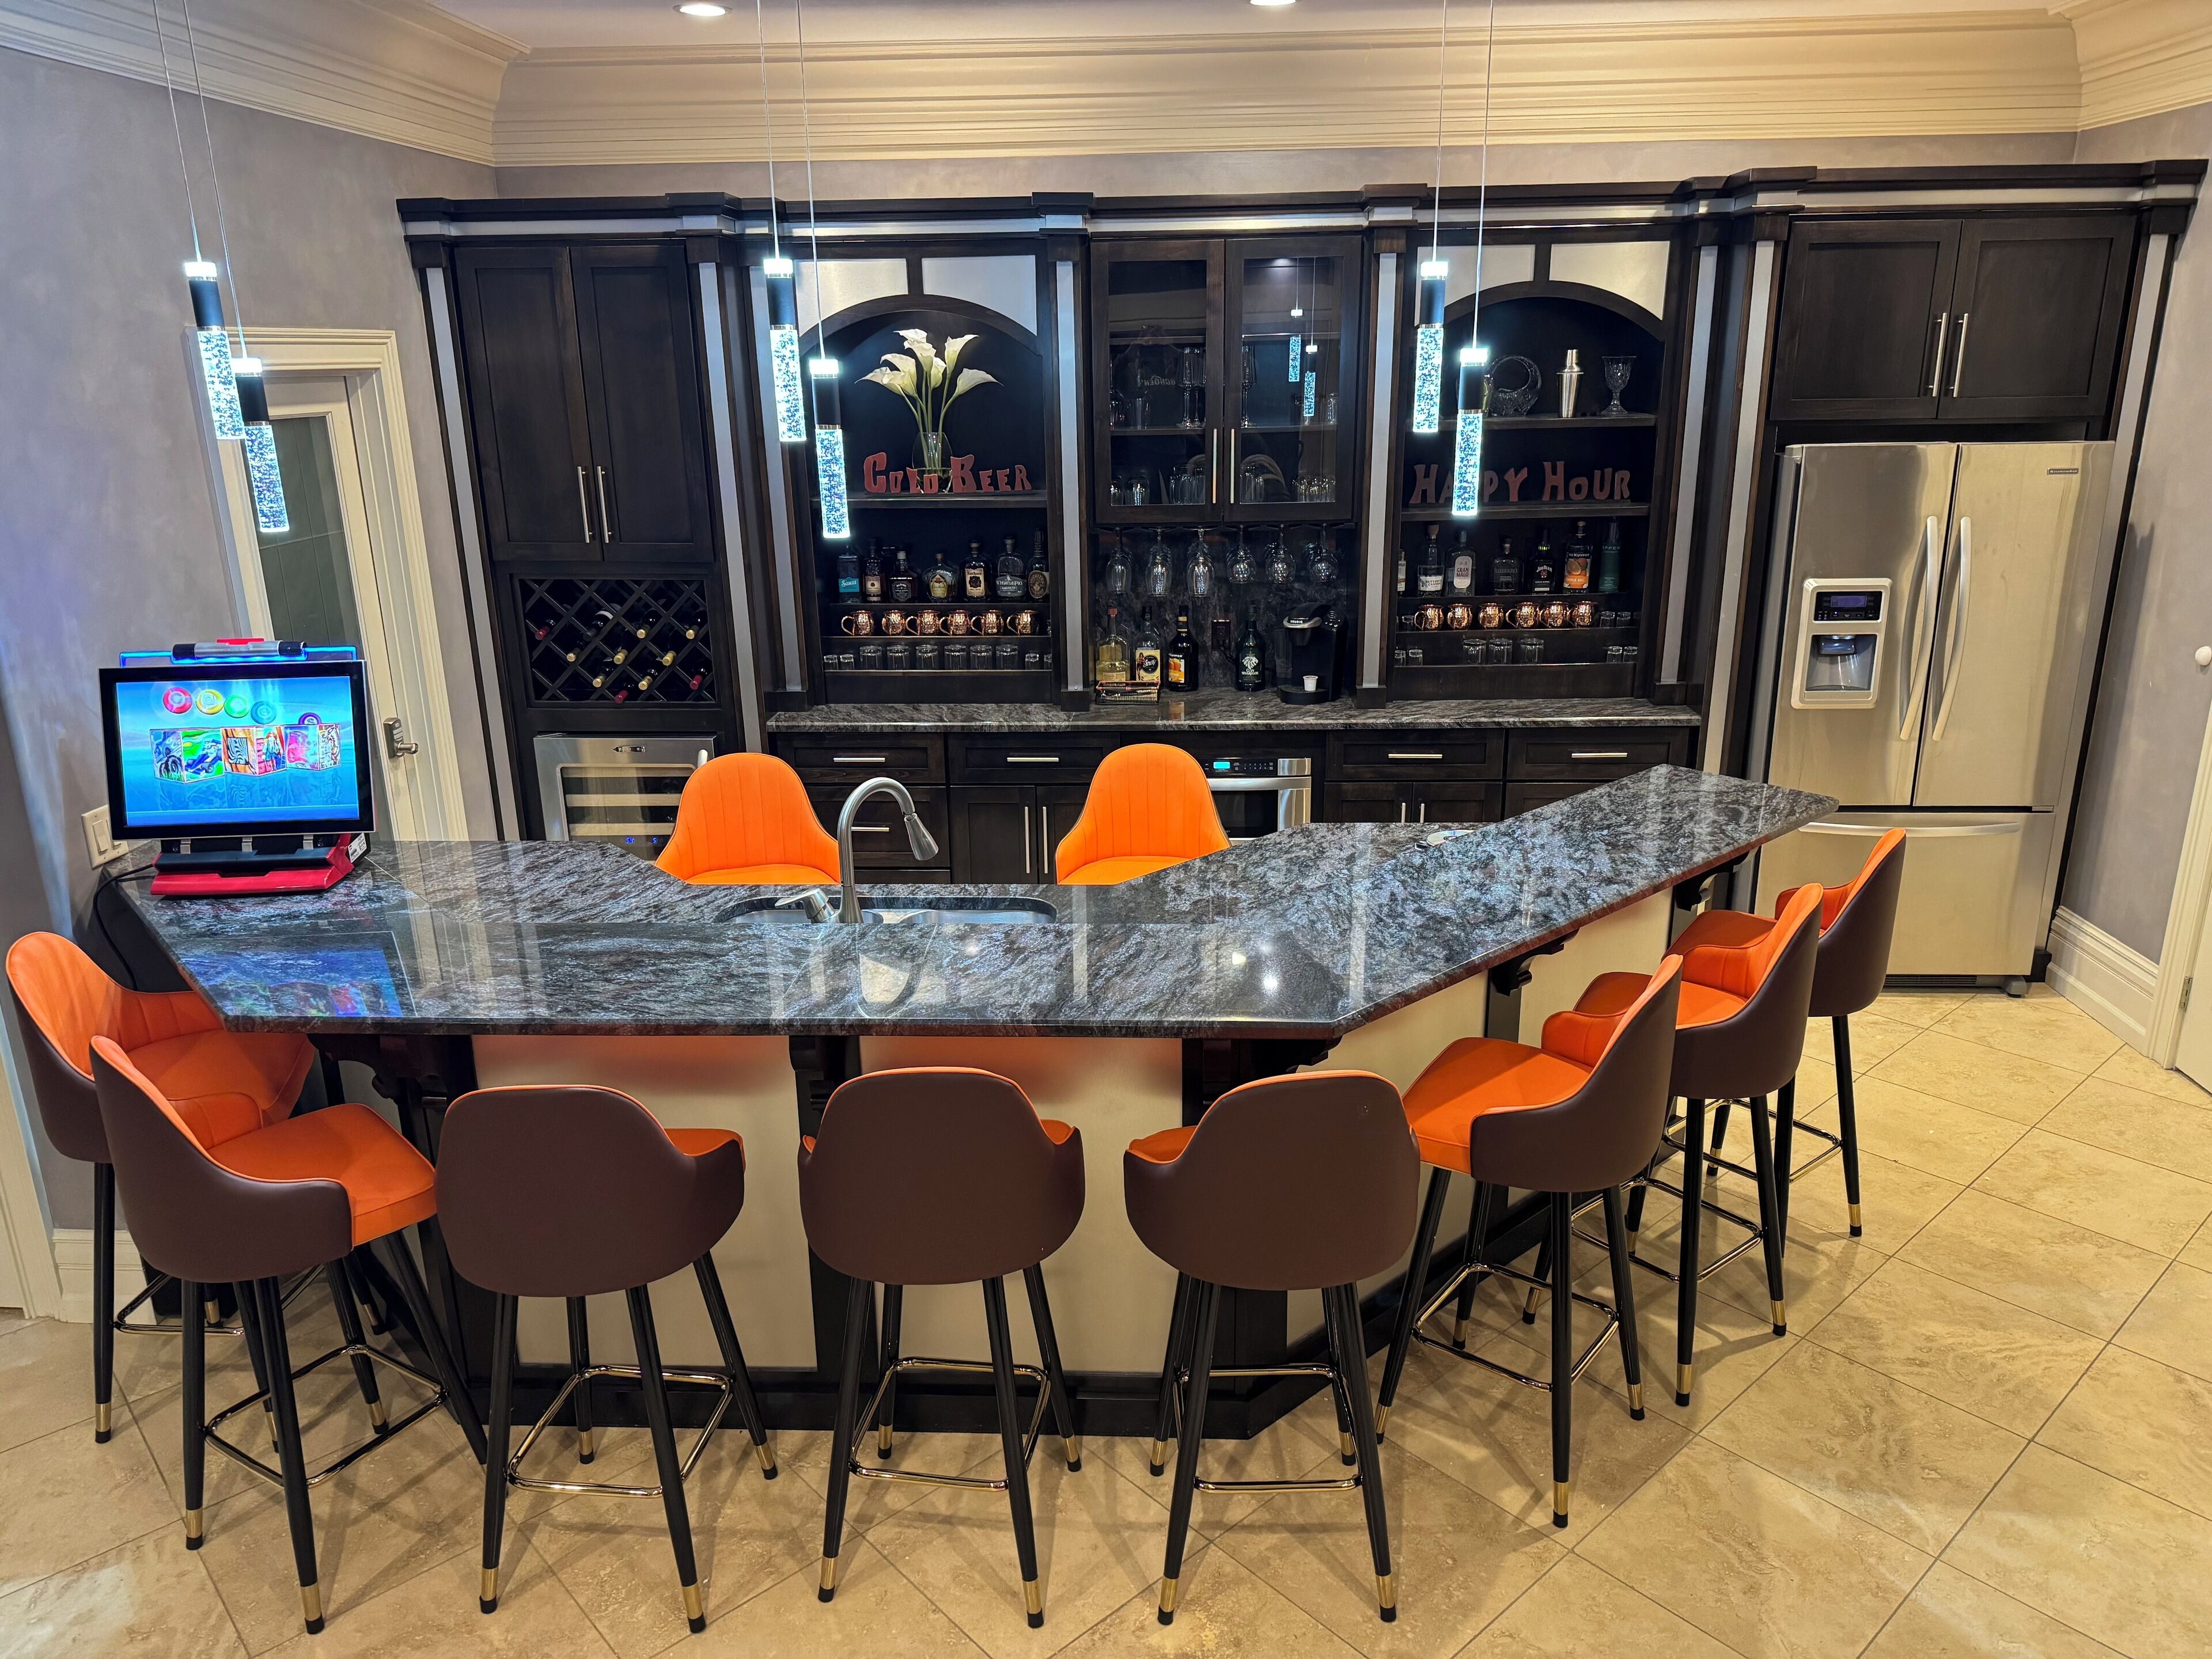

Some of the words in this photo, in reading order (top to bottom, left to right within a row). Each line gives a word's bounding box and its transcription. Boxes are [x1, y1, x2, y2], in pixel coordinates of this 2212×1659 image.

[863, 452, 938, 494] COLD
[950, 454, 1032, 494] BEER
[1409, 463, 1528, 504] HAPY
[1541, 460, 1631, 501] HOUR
